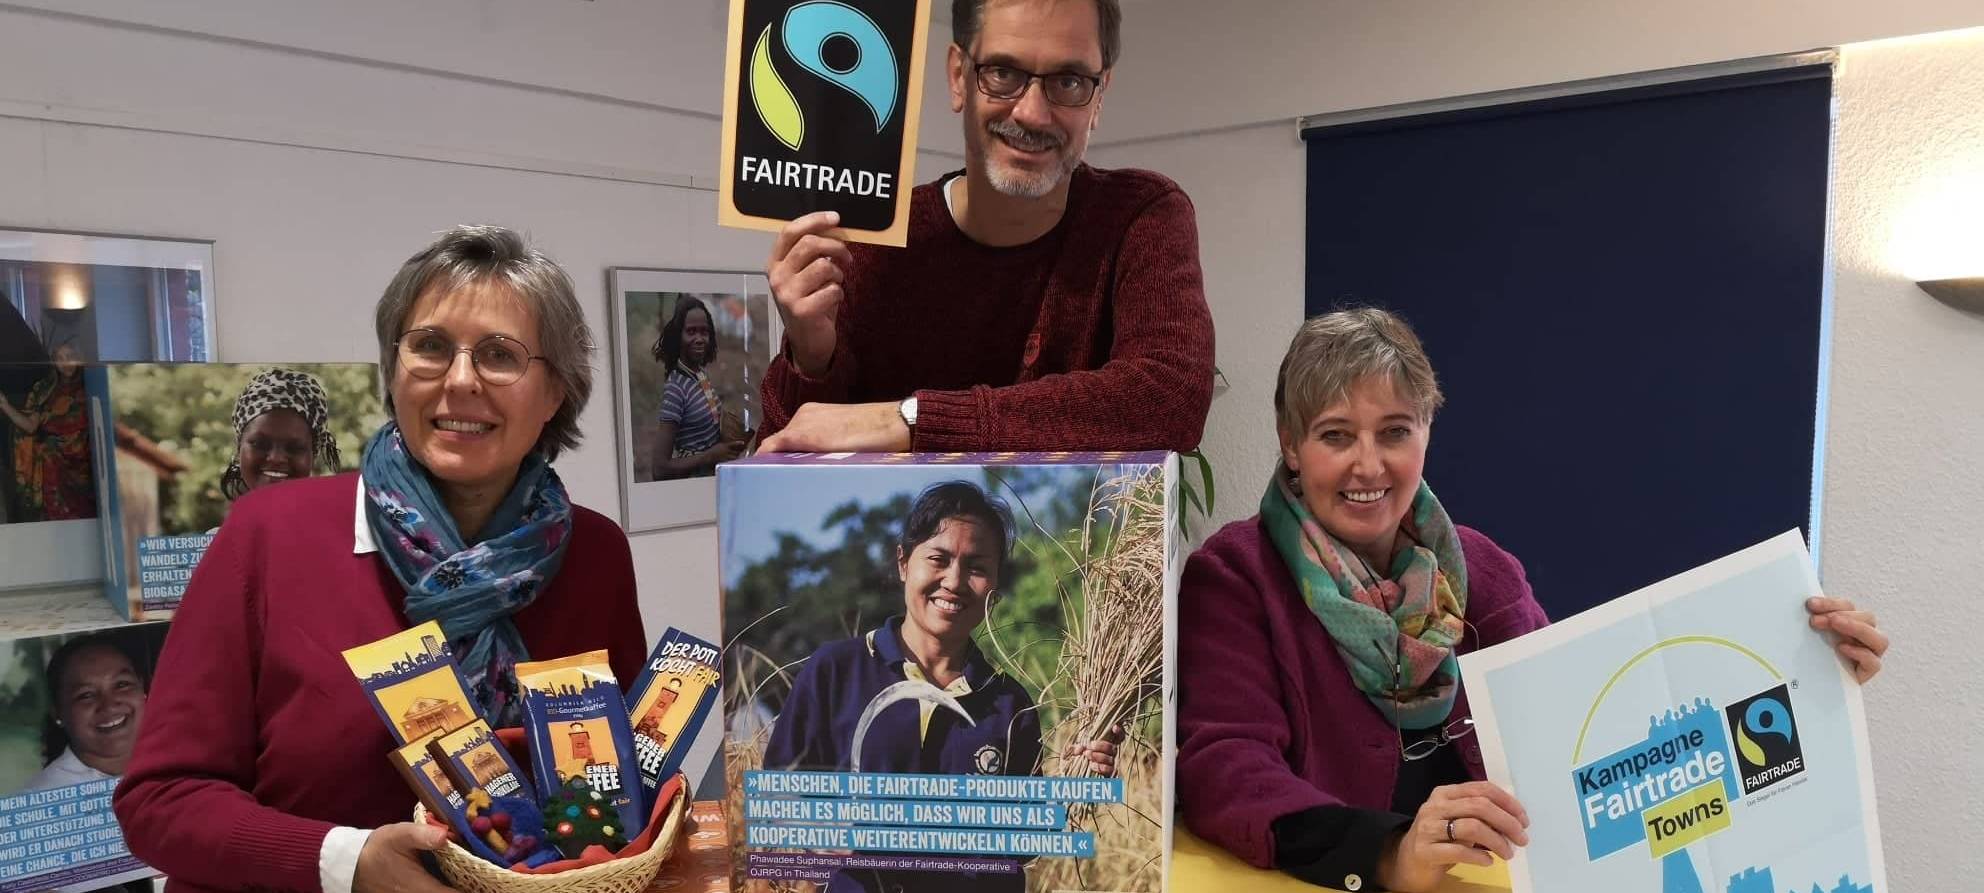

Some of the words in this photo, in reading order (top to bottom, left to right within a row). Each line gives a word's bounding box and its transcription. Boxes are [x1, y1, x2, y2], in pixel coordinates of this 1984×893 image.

[742, 156, 892, 198] FAIRTRADE
[141, 554, 189, 567] WANDELS
[661, 641, 691, 657] DER
[689, 644, 718, 665] POTT
[649, 658, 697, 677] KOCHT
[694, 666, 721, 688] FAIR
[1578, 729, 1704, 795] Kampagne
[1746, 757, 1801, 790] FAIRTRADE
[80, 780, 107, 796] SOHN
[749, 773, 844, 796] »MENSCHEN,
[849, 776, 872, 795] DIE
[877, 777, 1047, 799] FAIRTRADE-PRODUKTE
[1052, 781, 1117, 801] KAUFEN,
[1584, 750, 1726, 829] Fairtrade
[59, 803, 77, 816] MIT
[750, 801, 811, 819] MACHEN
[816, 802, 833, 820] ES
[838, 803, 908, 823] MÖGLICH,
[913, 805, 951, 823] DASS
[956, 805, 989, 824] WIR
[991, 806, 1022, 825] UNS
[1027, 807, 1055, 826] ALS
[1648, 797, 1724, 841] Towns
[0, 845, 26, 860] WIRD
[29, 842, 42, 855] ER
[45, 834, 84, 851] DANACH
[750, 827, 848, 847] KOOPERATIVE
[852, 829, 1006, 851] WEITERENTWICKELN
[1011, 832, 1087, 853] KÖNNEN.«
[0, 862, 24, 878] EINE
[72, 850, 87, 863] DIE
[90, 845, 106, 858] ICH
[750, 854, 795, 864] Phawadee
[846, 857, 897, 868] Reisbäuerin
[898, 859, 913, 868] der
[915, 860, 1011, 872] Fairtrade-Kooperative
[750, 868, 782, 878] OJRPG
[784, 869, 792, 877] in
[794, 869, 831, 879] Thailand
